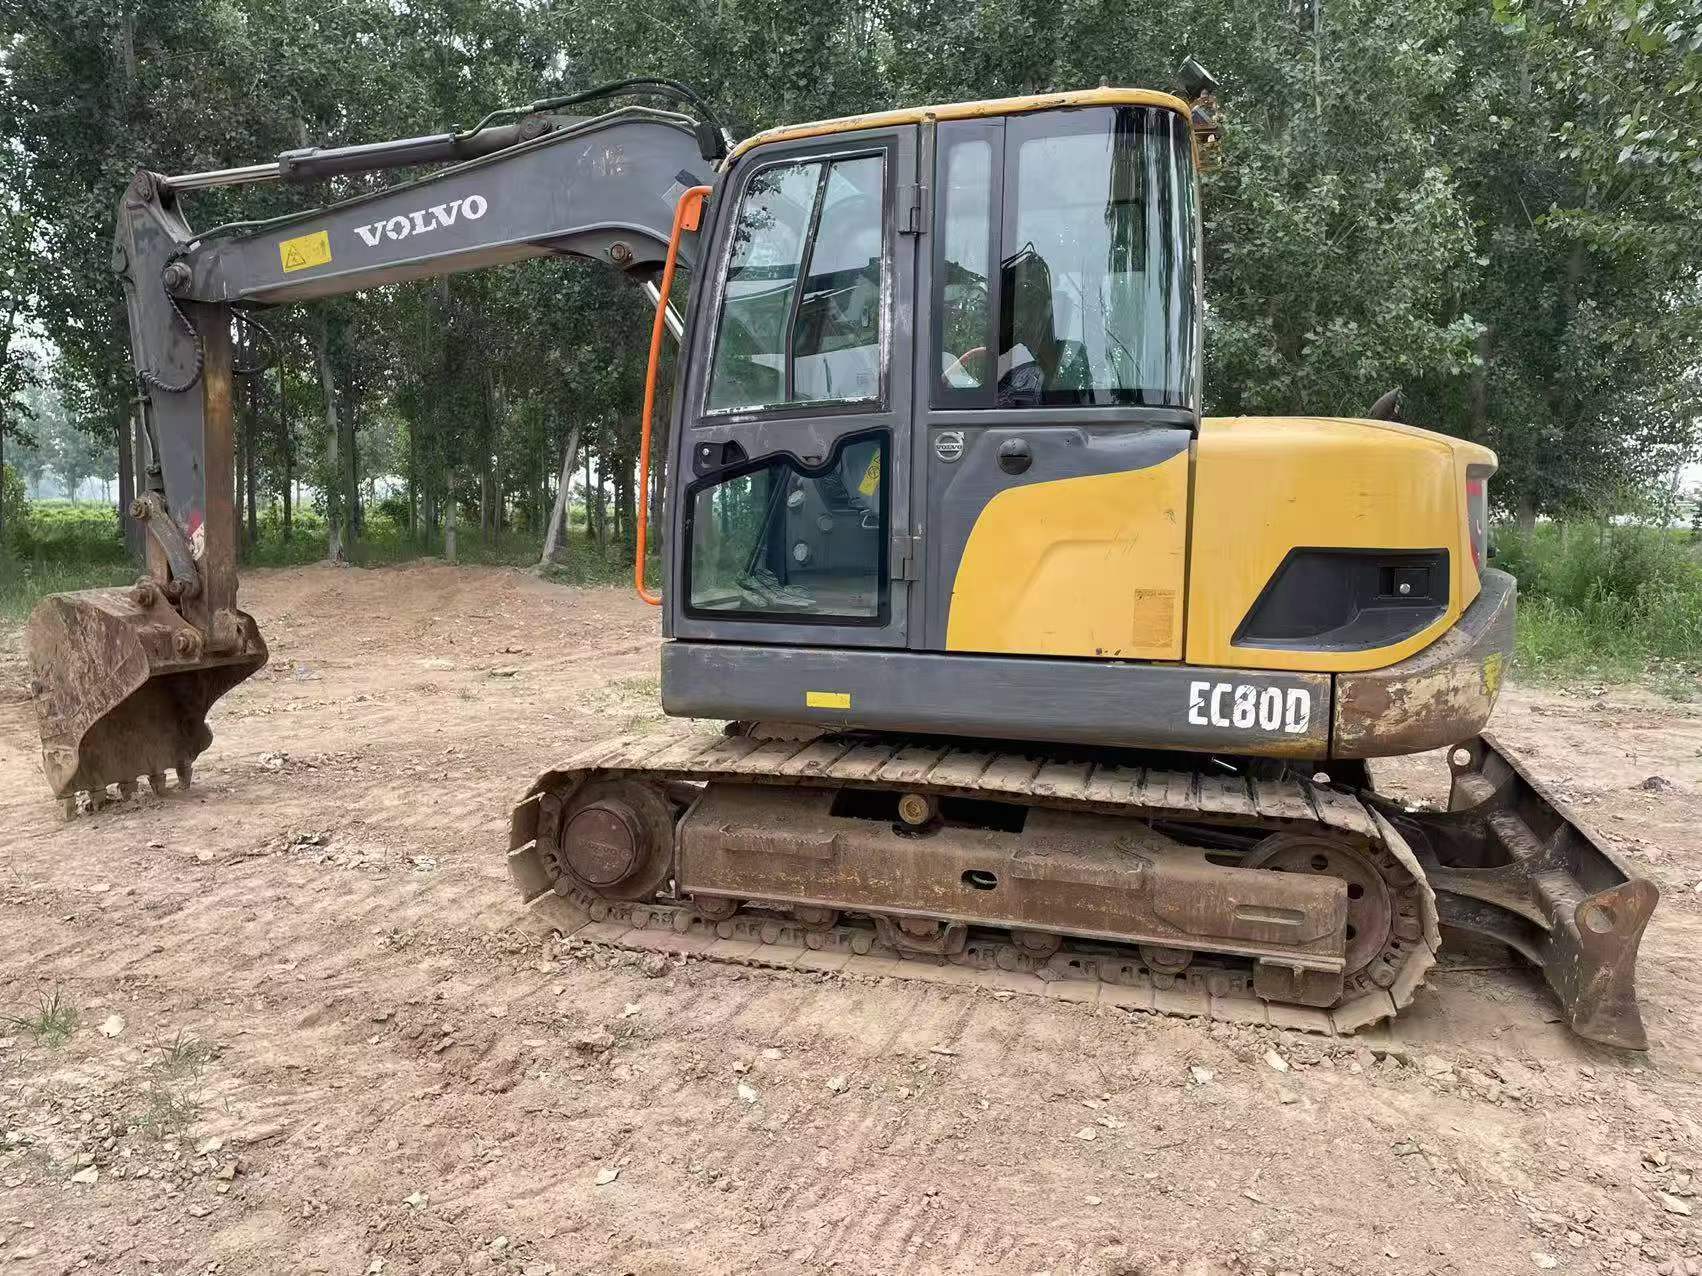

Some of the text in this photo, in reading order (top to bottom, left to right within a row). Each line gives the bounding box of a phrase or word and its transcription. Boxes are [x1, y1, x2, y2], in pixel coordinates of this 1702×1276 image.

[354, 195, 488, 246] VOLVO
[936, 443, 963, 451] VOLVO
[1188, 681, 1311, 734] EC80D
